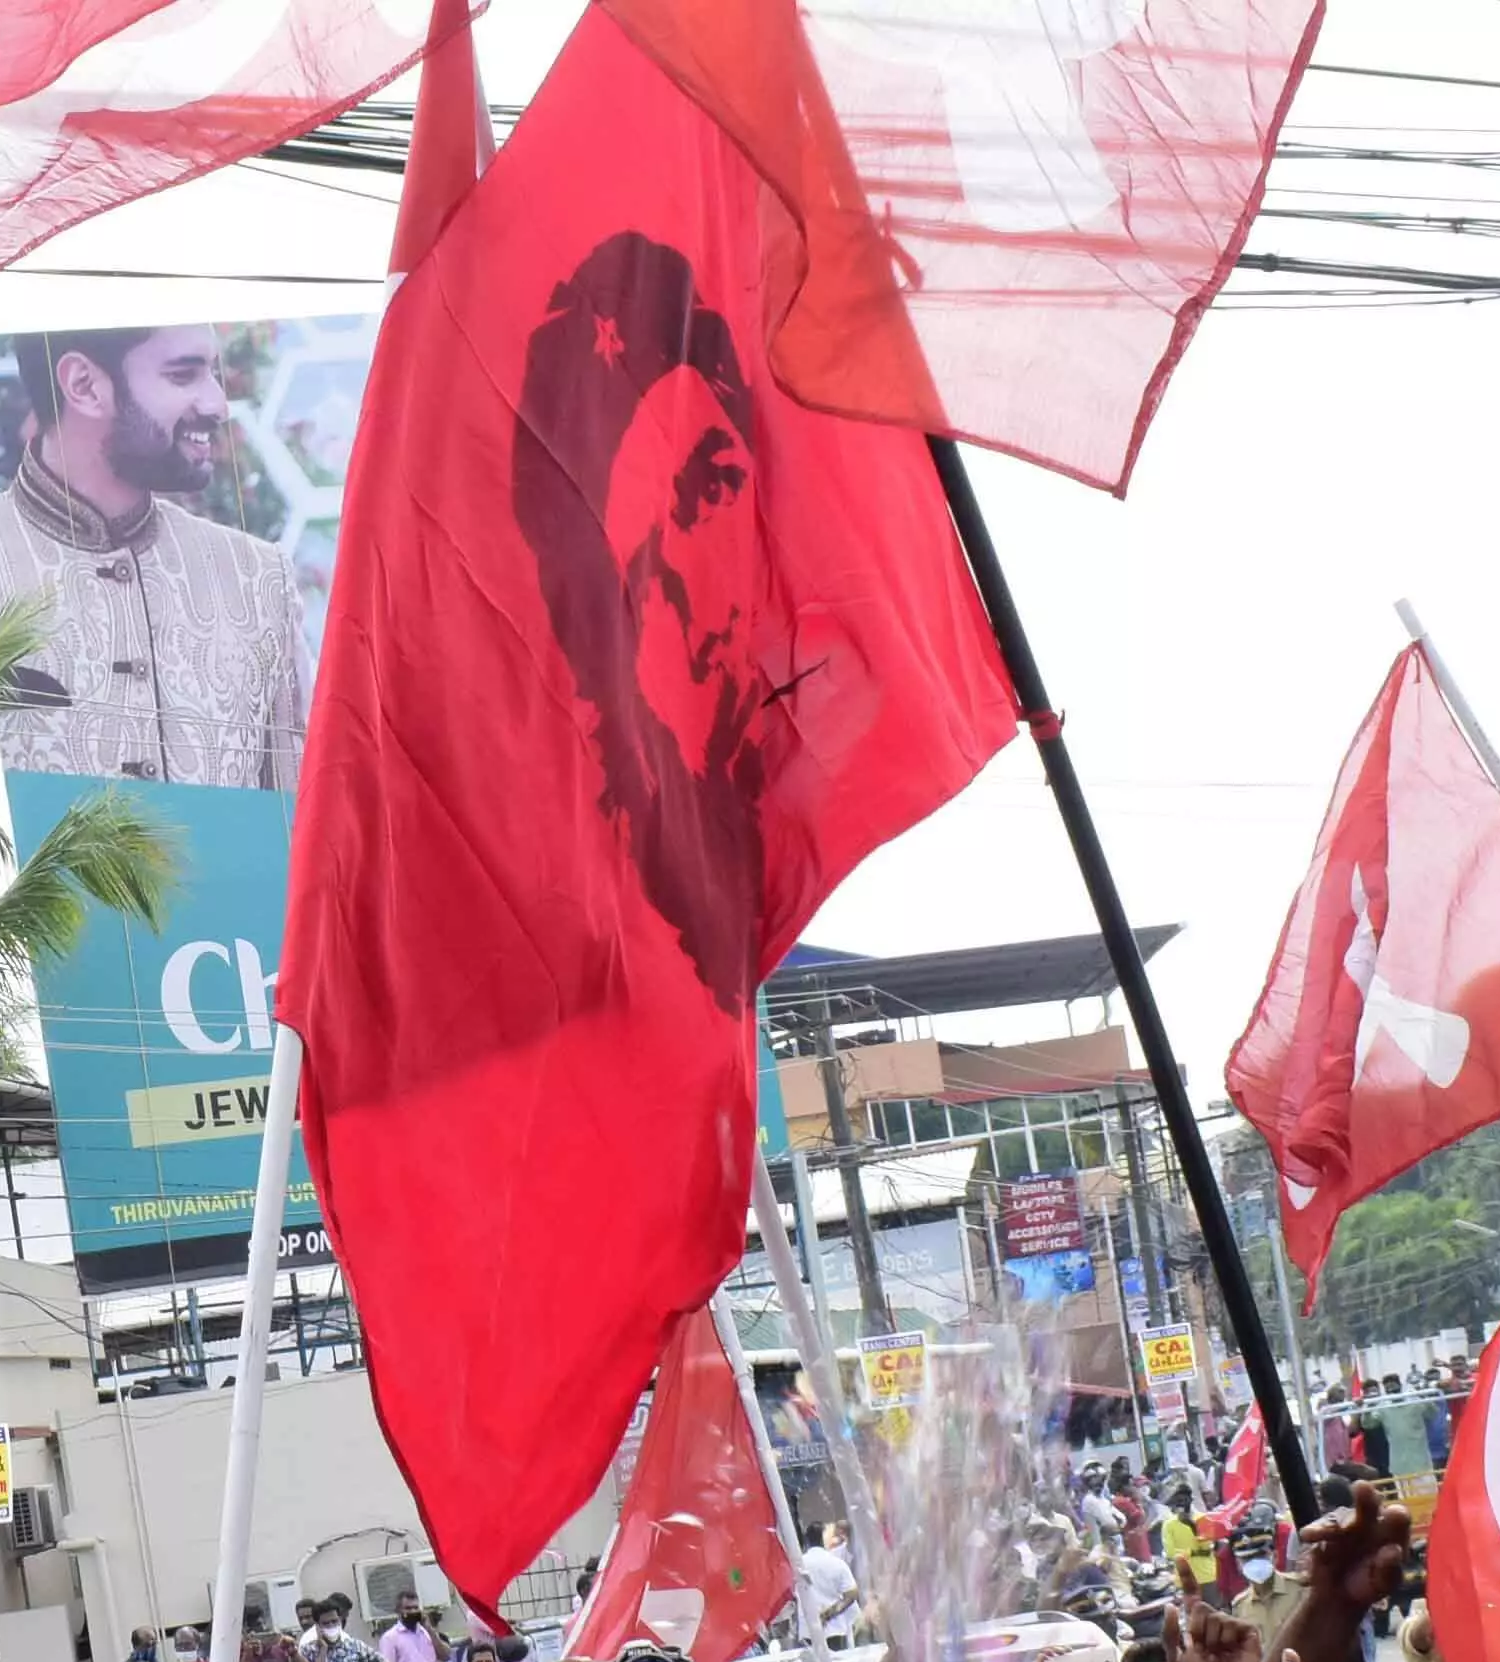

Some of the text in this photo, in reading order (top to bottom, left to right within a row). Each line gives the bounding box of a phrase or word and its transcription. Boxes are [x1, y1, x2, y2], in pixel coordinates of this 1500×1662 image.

[160, 938, 280, 1053] Ch
[184, 1085, 270, 1130] JEW
[110, 1182, 318, 1225] THIRUVANANTHUR
[1025, 1210, 1056, 1223] CCTV
[1020, 1237, 1069, 1253] SERVICE
[1154, 1339, 1183, 1354] CA
